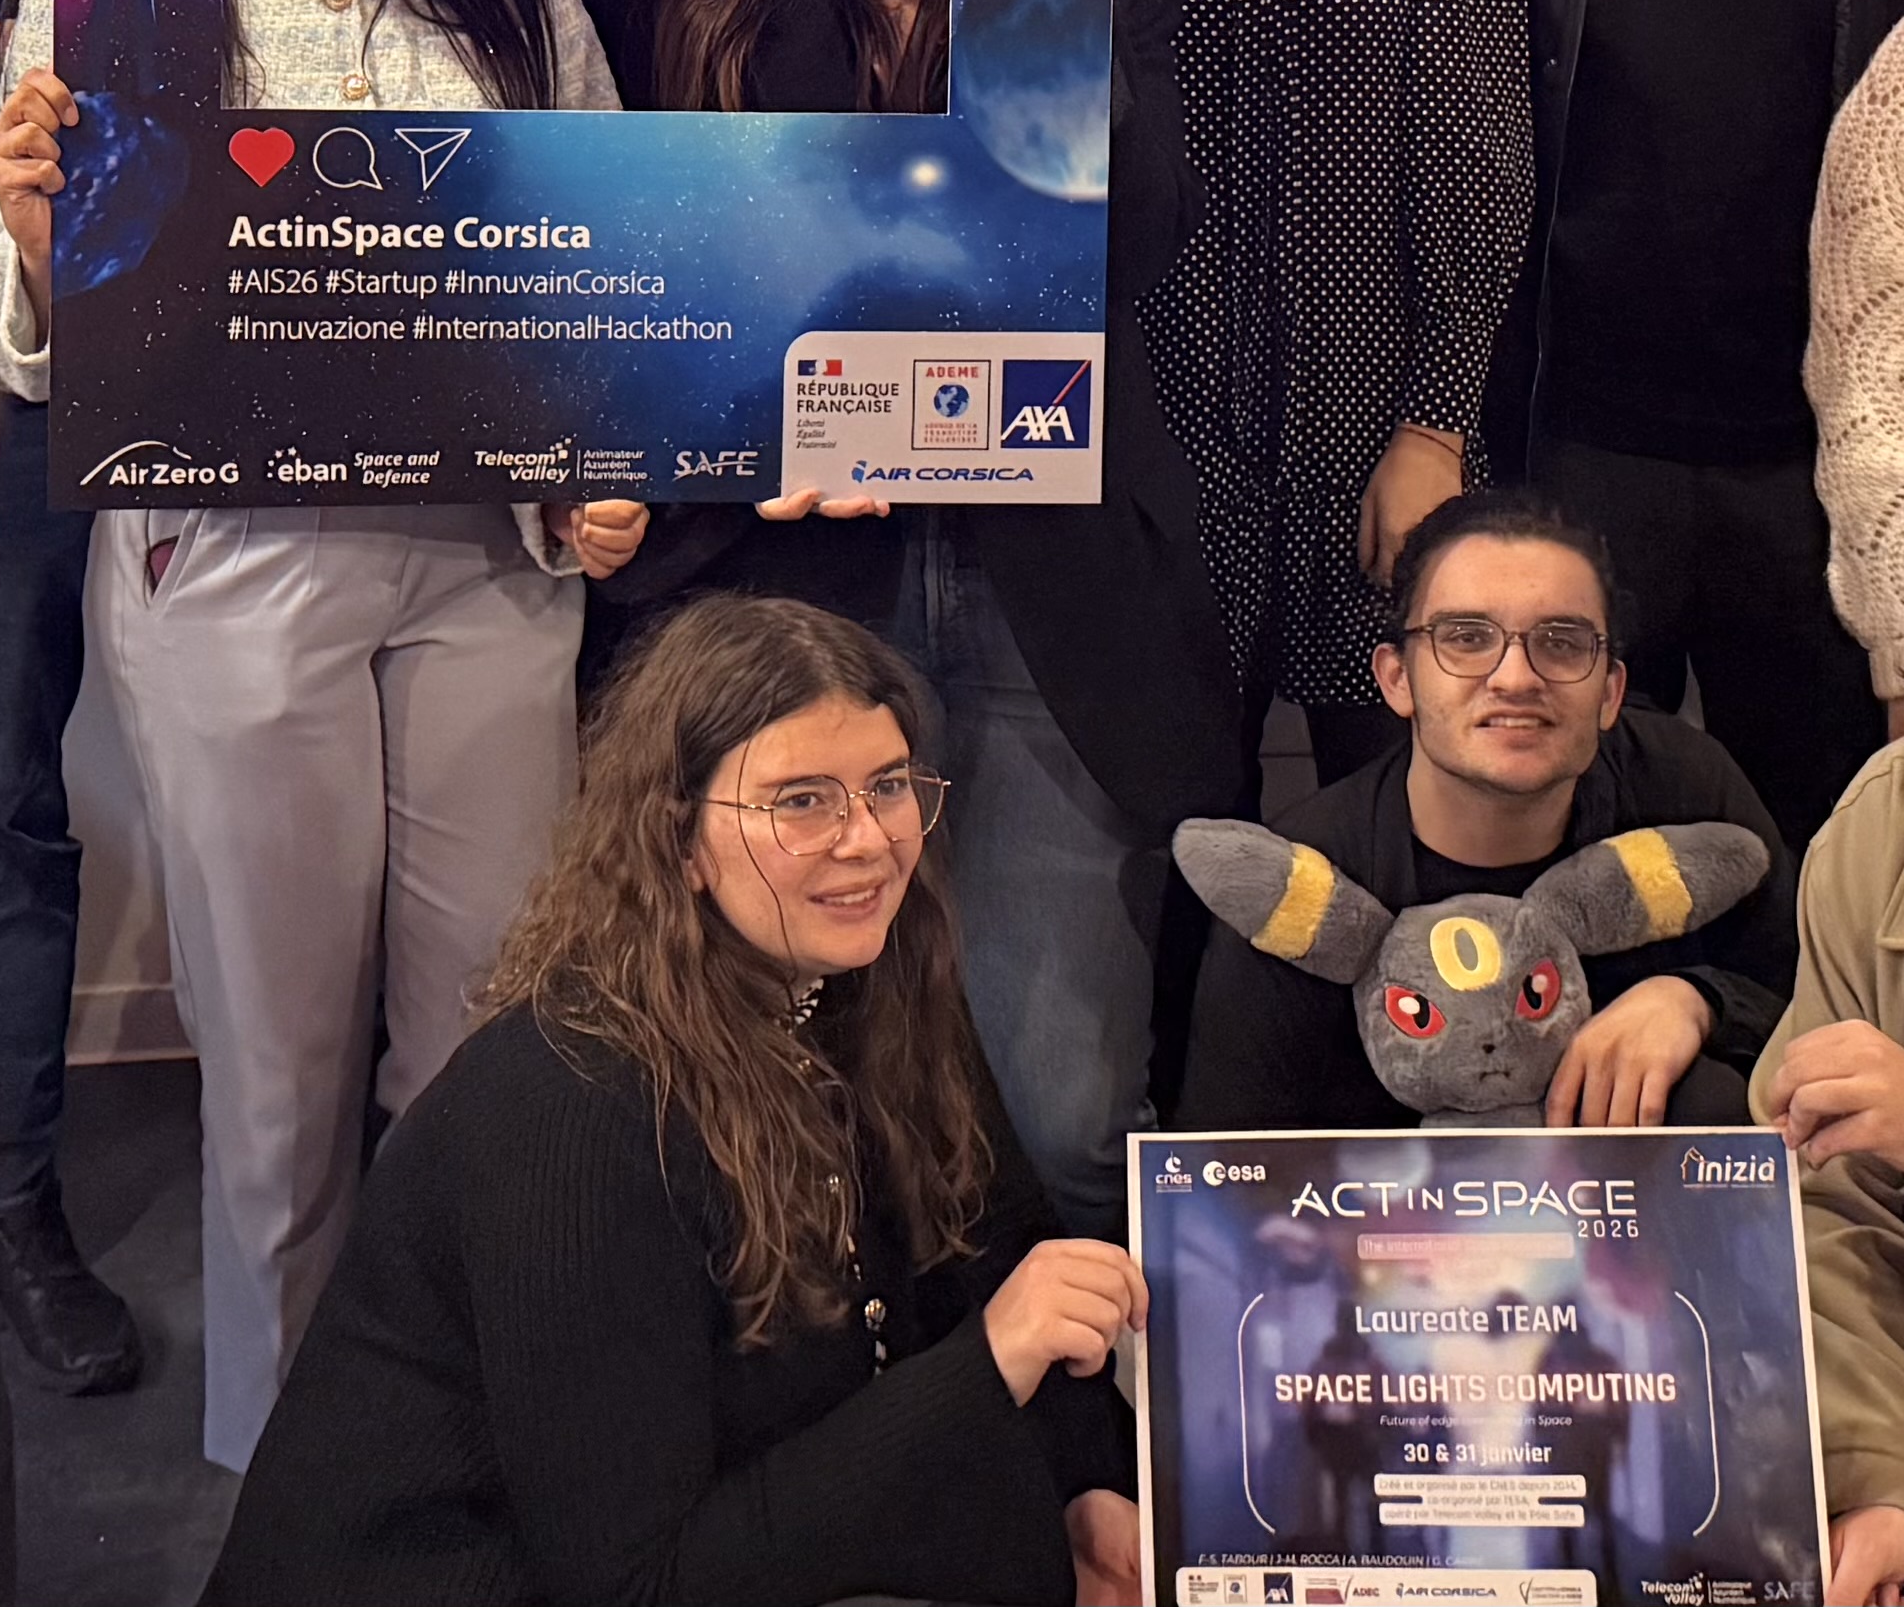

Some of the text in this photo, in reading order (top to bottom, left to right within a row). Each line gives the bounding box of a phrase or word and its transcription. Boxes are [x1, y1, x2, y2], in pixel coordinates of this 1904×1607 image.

[229, 217, 591, 255] ActinSpace Corsica
[228, 268, 665, 299] #AIS26 #Startup #InnuvainCorsica
[227, 314, 733, 341] #Innuvazione #InternationalHackathon
[926, 366, 980, 378] ADEME
[797, 380, 900, 398] RÉPUBLIQUE
[797, 400, 893, 415] FRANÇAISE
[1001, 405, 1076, 442] AXA
[354, 451, 440, 468] Space and
[474, 450, 556, 466] Telecom
[674, 451, 759, 477] SAFE
[277, 457, 347, 482] eban
[865, 467, 1034, 481] AIR CORSICA
[362, 470, 431, 488] Defence
[1227, 1165, 1267, 1182] esa
[1697, 1155, 1777, 1183] inizià
[1156, 1174, 1192, 1185] cnes
[1291, 1180, 1637, 1218] ACT IN SPACE
[1577, 1220, 1640, 1238] 2026
[1355, 1305, 1577, 1333] Laureate TEAM
[1275, 1372, 1677, 1403] SPACE LIGHTS COMPUTING
[1379, 1415, 1416, 1426] Future
[1418, 1415, 1431, 1426] of
[1538, 1415, 1573, 1427] Space
[1404, 1442, 1553, 1466] 30 & 31 janvier
[1300, 1554, 1340, 1565] ROCCA
[1360, 1554, 1425, 1566] BAUDOUIN
[1352, 1587, 1380, 1597] ADEC
[1430, 1588, 1497, 1596] CORSICA
